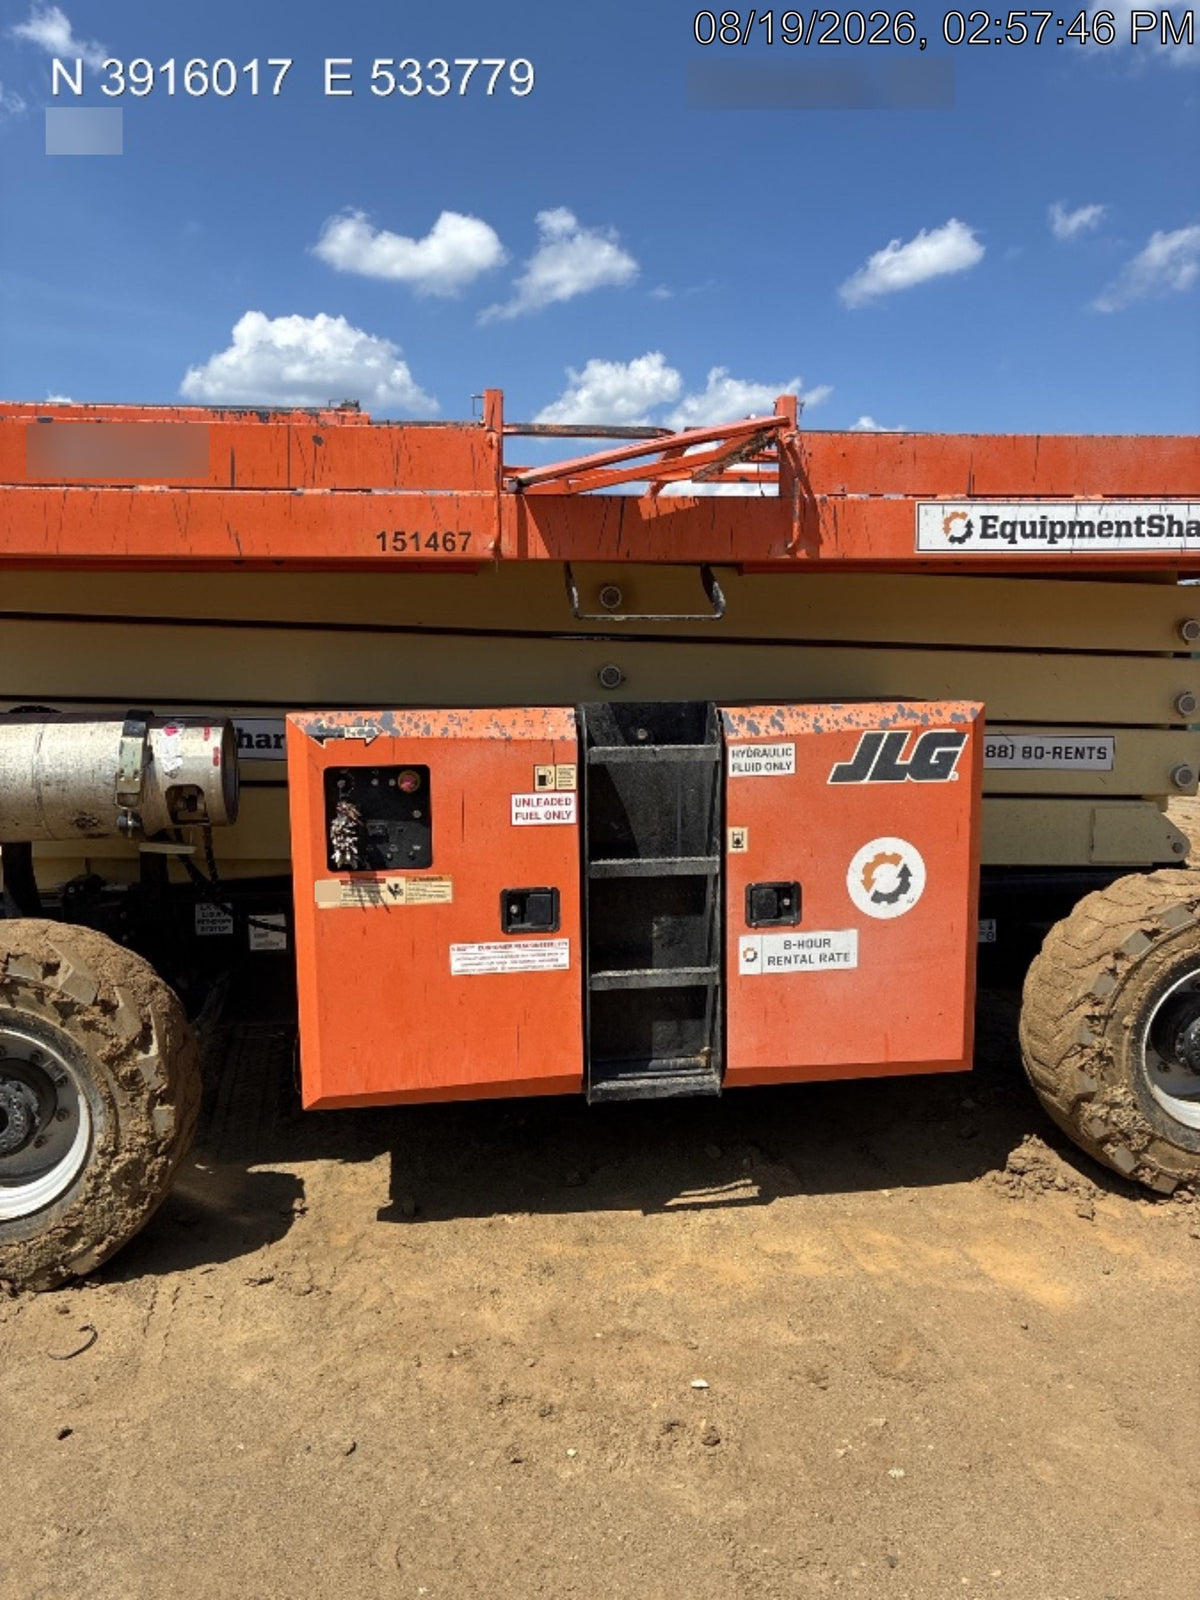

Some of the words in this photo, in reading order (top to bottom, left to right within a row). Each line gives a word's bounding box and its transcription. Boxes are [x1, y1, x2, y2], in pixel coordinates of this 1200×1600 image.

[376, 531, 472, 552] 151467
[731, 747, 792, 759] HYDRAULIC
[826, 728, 969, 785] JLG
[731, 762, 762, 773] FLUID
[764, 761, 792, 772] ONLY
[514, 797, 572, 808] UNLEADED
[514, 812, 542, 821] FUEL
[543, 810, 573, 821] ONLY
[783, 938, 832, 950] 8-HOUR
[767, 953, 815, 967] RENTAL
[818, 952, 851, 964] RATE
